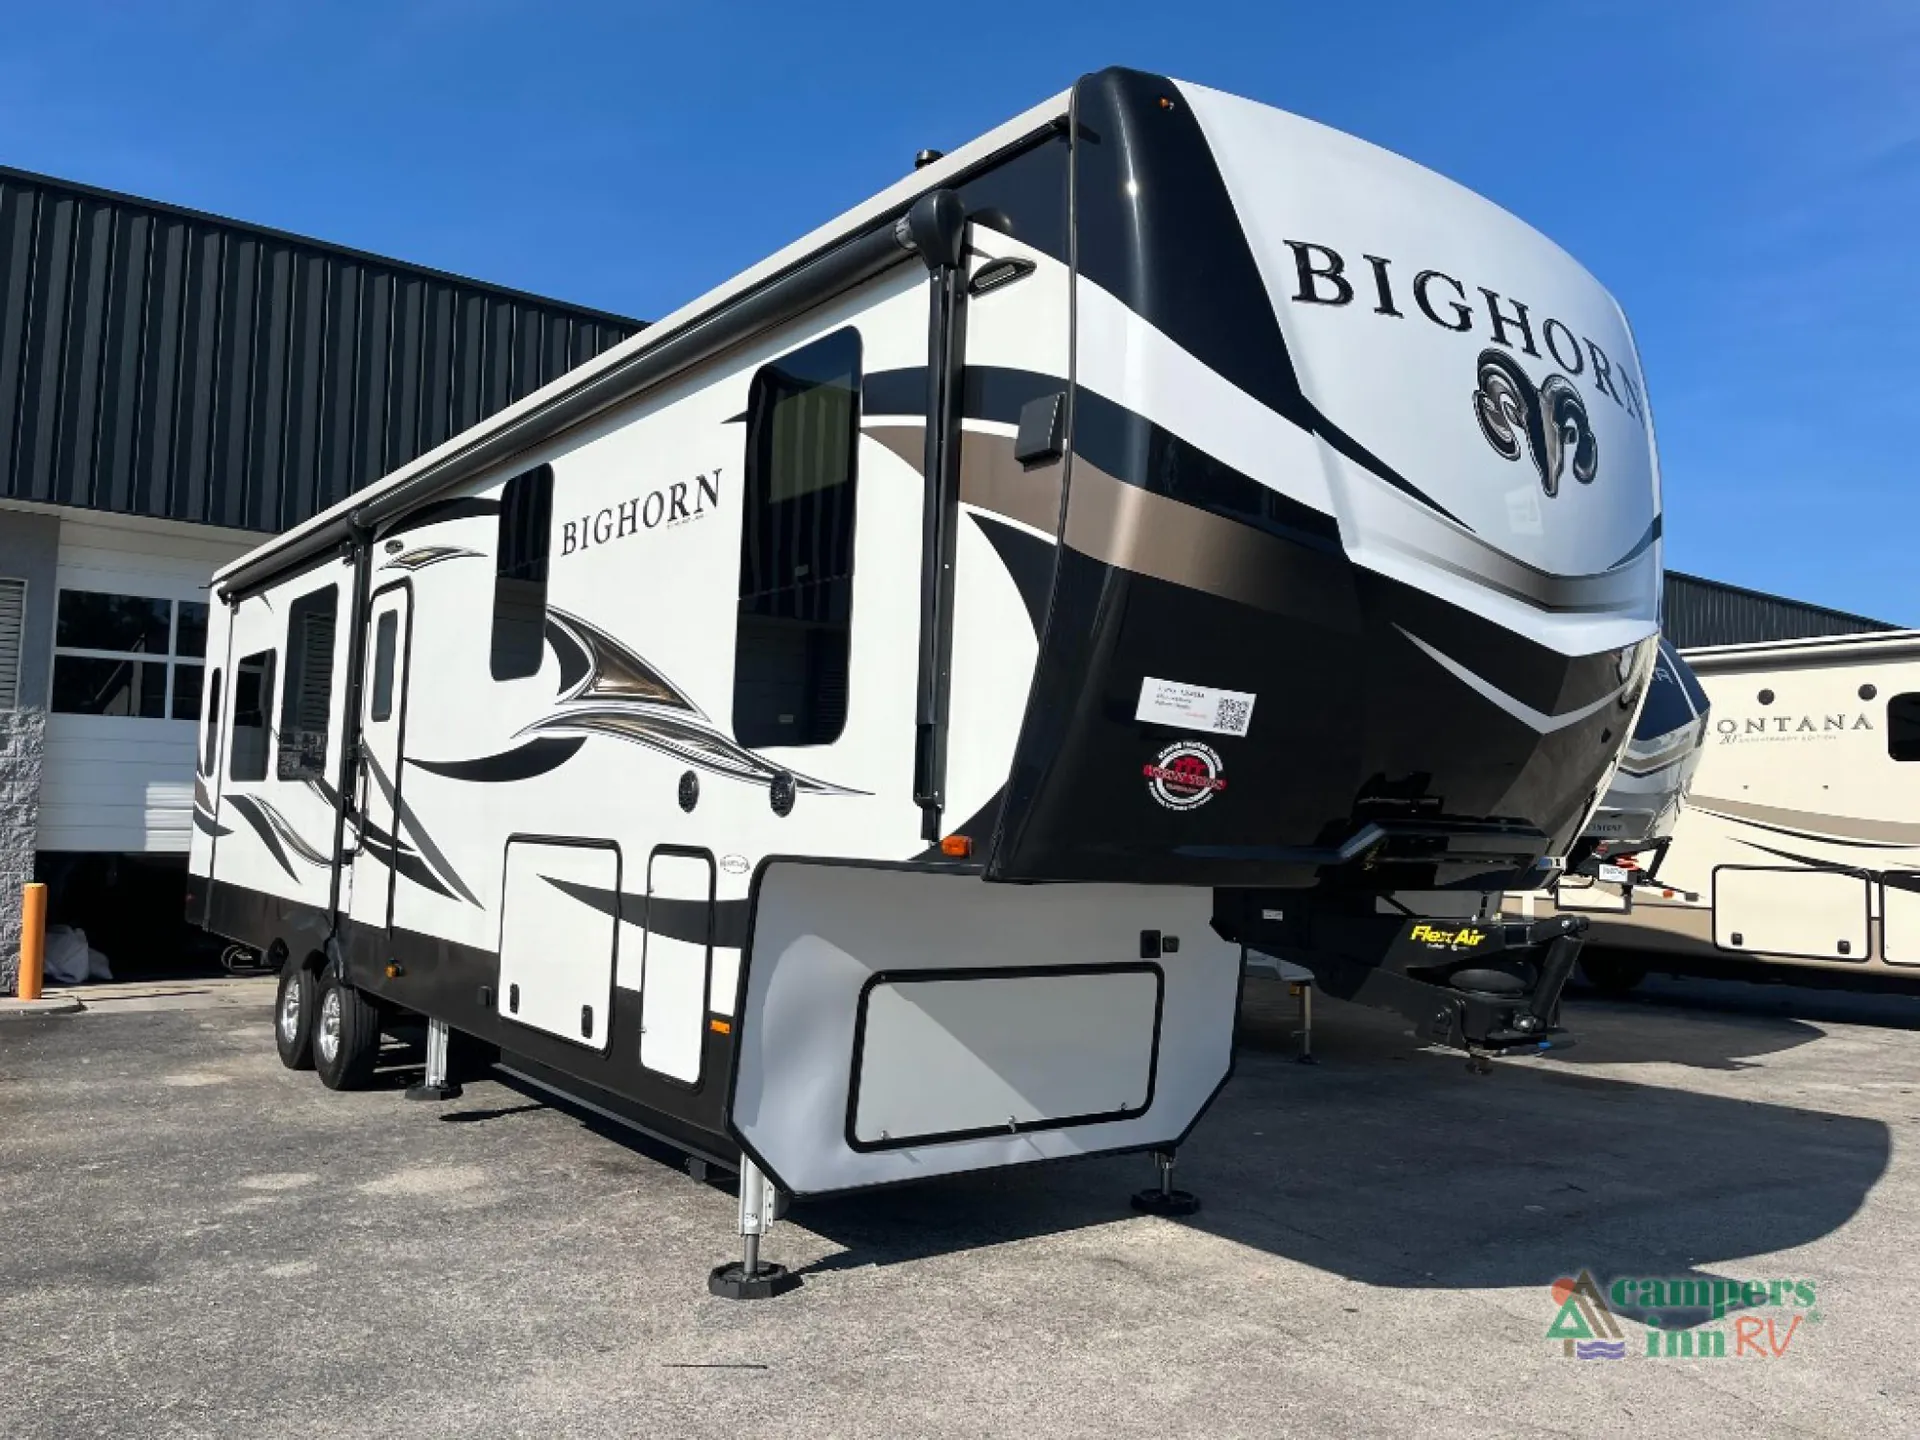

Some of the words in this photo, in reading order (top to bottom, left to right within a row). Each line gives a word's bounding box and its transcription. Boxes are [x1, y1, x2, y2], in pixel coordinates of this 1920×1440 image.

[1282, 239, 1647, 431] BIGHORN
[560, 467, 723, 558] BIGHORN
[1716, 712, 1874, 734] ONTANA
[1453, 928, 1486, 946] Air
